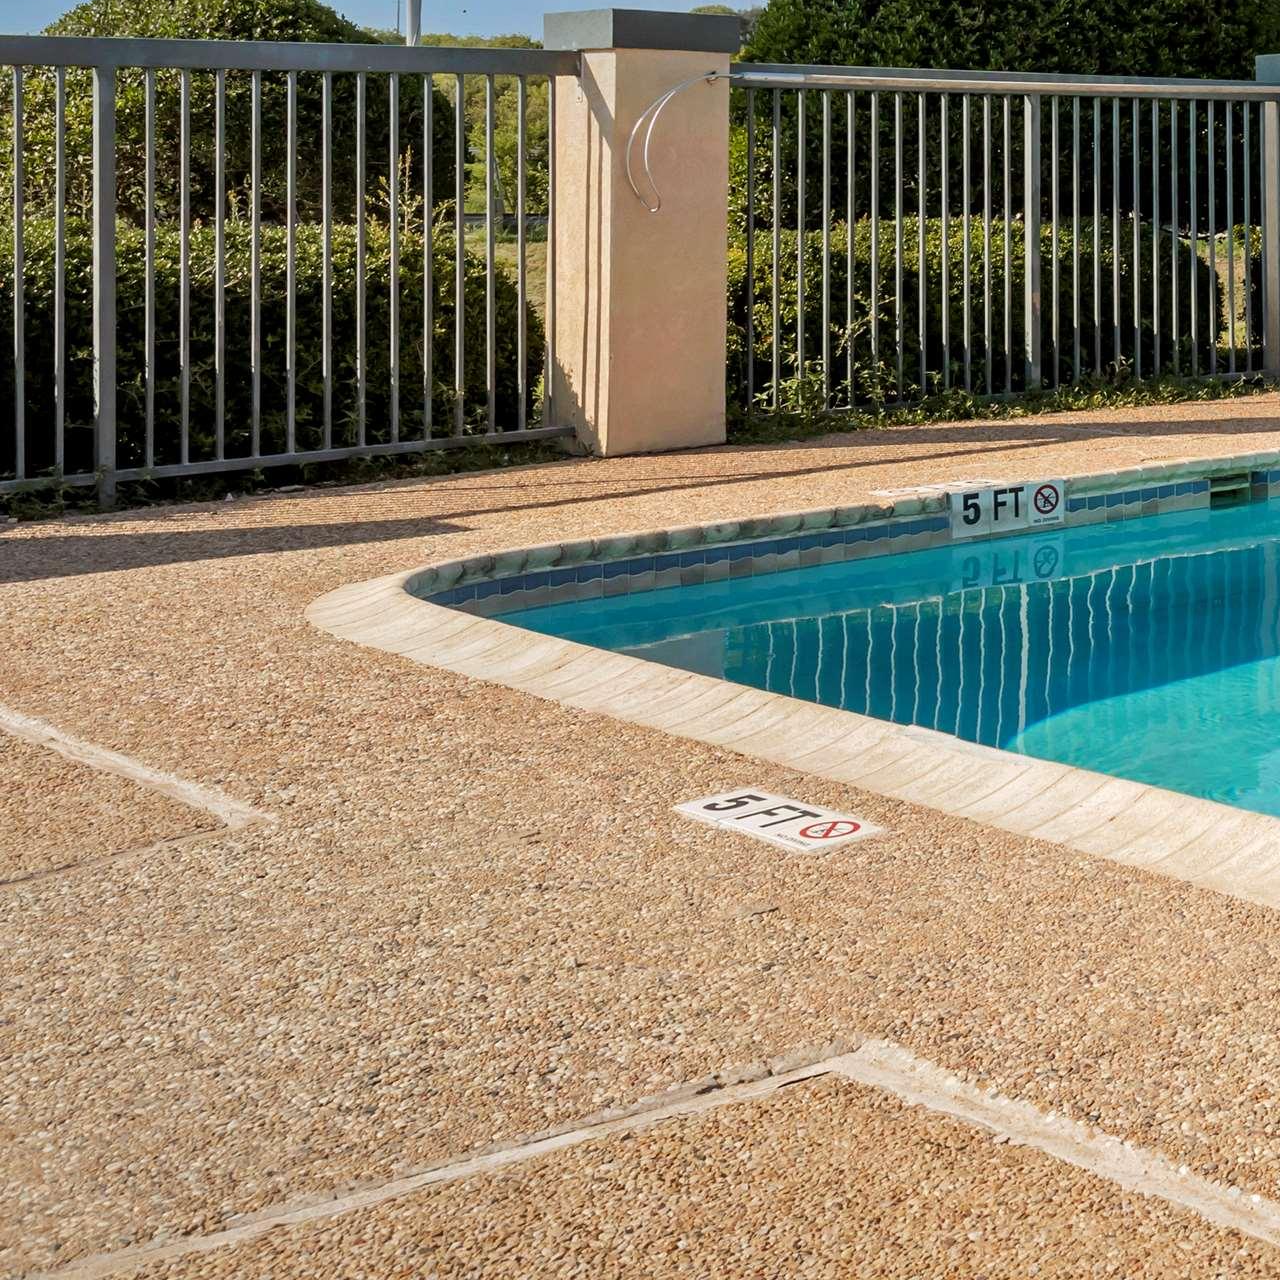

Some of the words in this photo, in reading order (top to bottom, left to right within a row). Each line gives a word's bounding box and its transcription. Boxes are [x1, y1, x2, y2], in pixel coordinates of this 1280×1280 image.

[962, 493, 981, 525] 5
[993, 486, 1024, 520] FT
[702, 794, 768, 811] 5
[733, 805, 823, 828] FT
